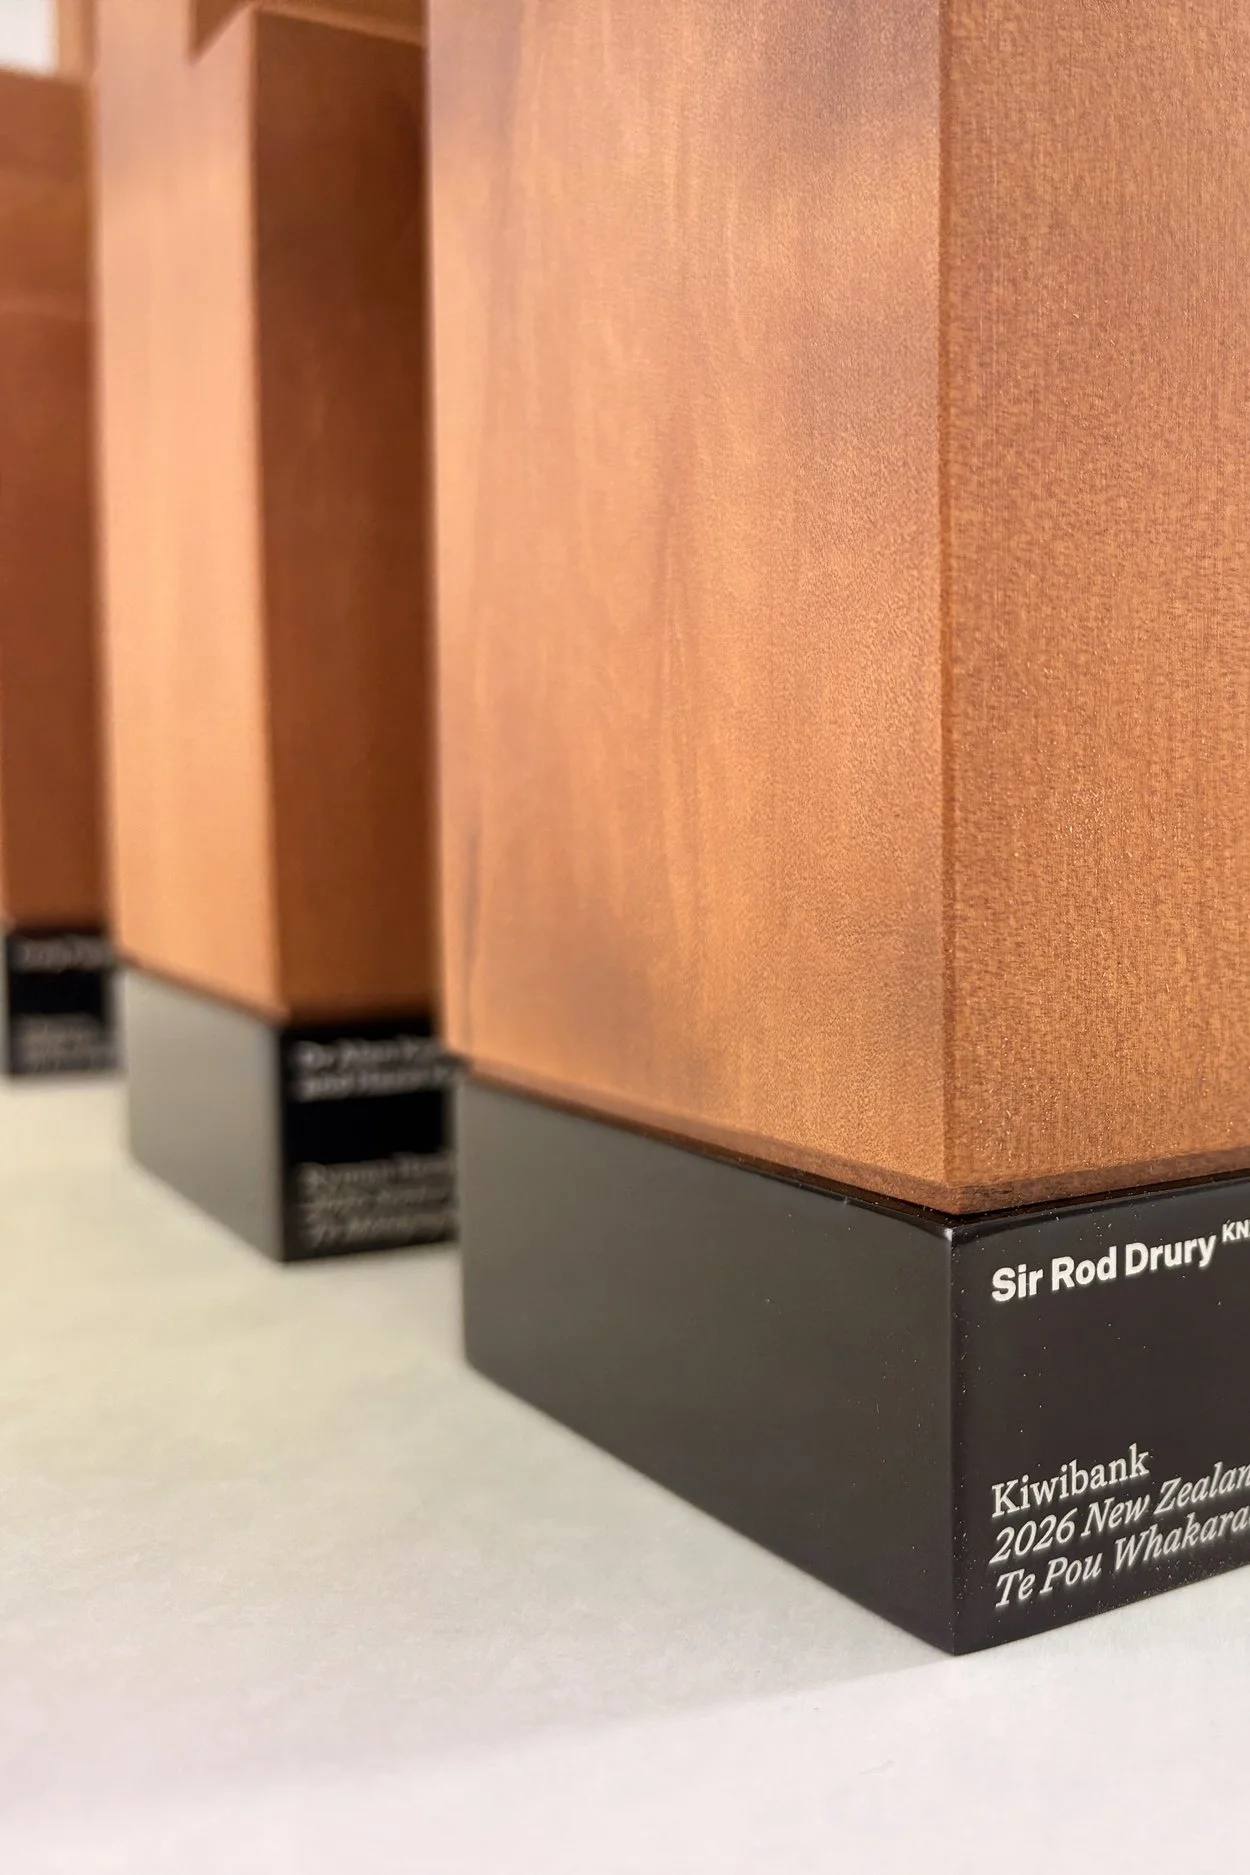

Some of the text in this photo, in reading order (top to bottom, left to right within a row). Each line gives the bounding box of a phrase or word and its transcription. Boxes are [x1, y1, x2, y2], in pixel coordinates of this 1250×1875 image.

[991, 1263, 1043, 1301] Sir
[1051, 1246, 1117, 1291] Rod
[1125, 1234, 1216, 1275] Drury
[991, 1443, 1149, 1517] Kiwibank
[989, 1515, 1074, 1563] 2026
[1080, 1495, 1150, 1537] New
[995, 1570, 1034, 1607] Te
[1041, 1552, 1102, 1592] Pou
